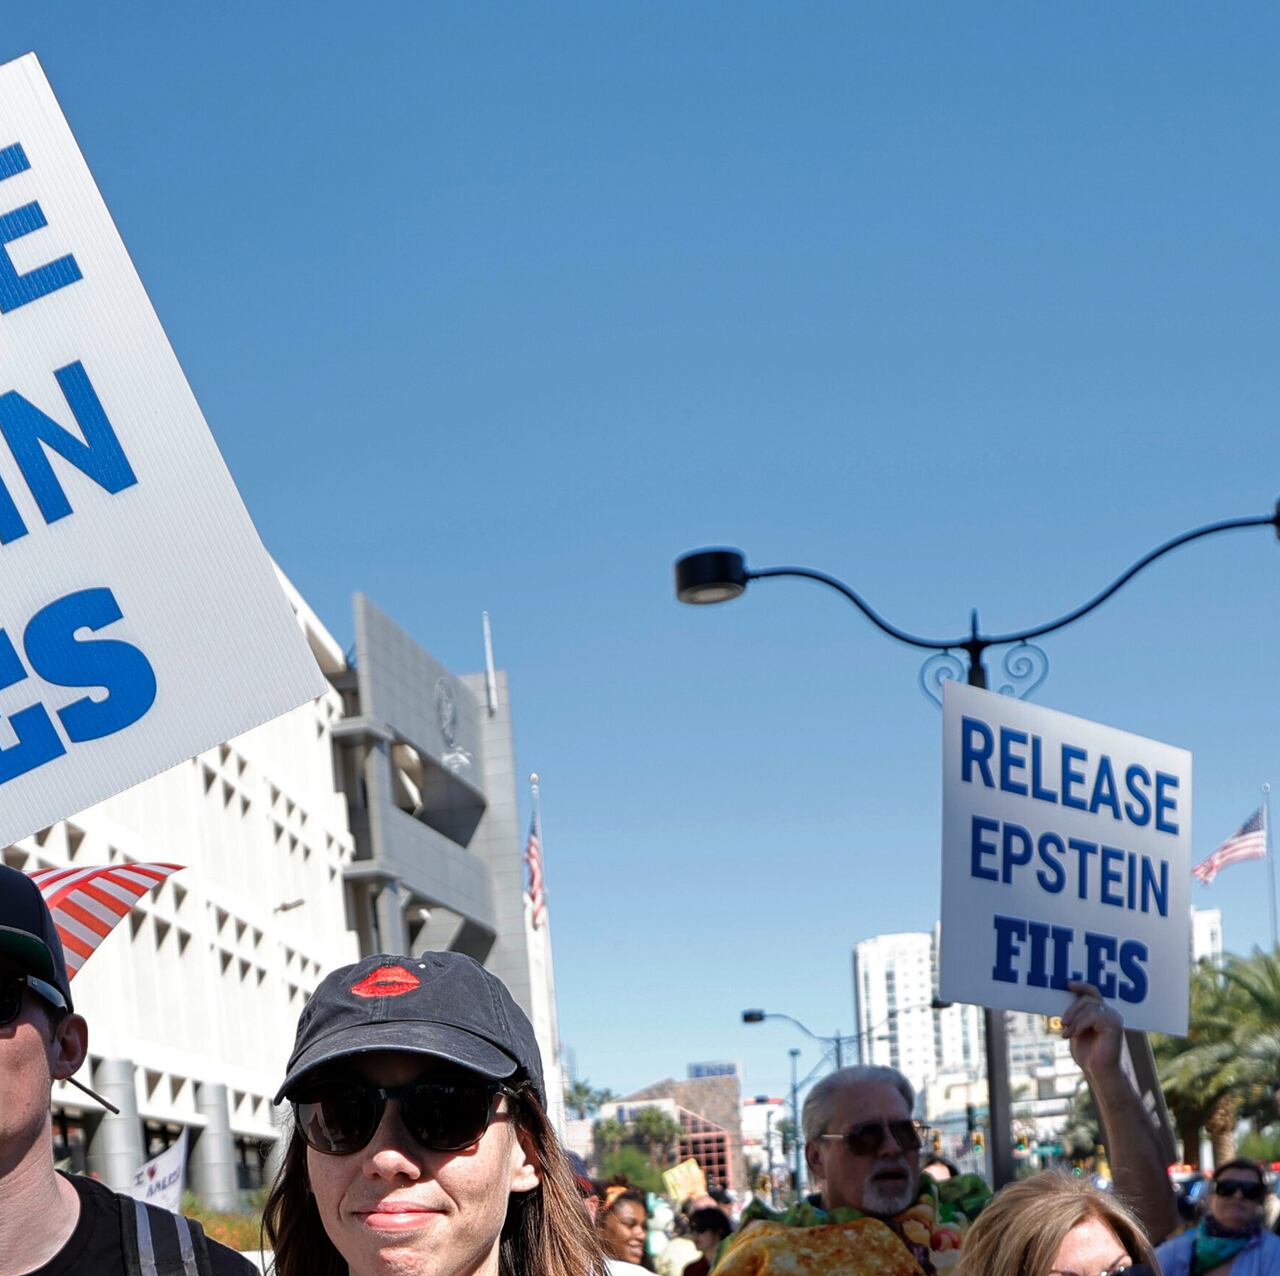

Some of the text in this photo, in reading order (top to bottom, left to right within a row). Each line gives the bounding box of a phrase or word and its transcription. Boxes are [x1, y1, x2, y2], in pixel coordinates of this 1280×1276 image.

[961, 714, 1179, 836] RELEASE
[971, 814, 1169, 917] EPSTEIN
[992, 914, 1149, 1005] FILES
